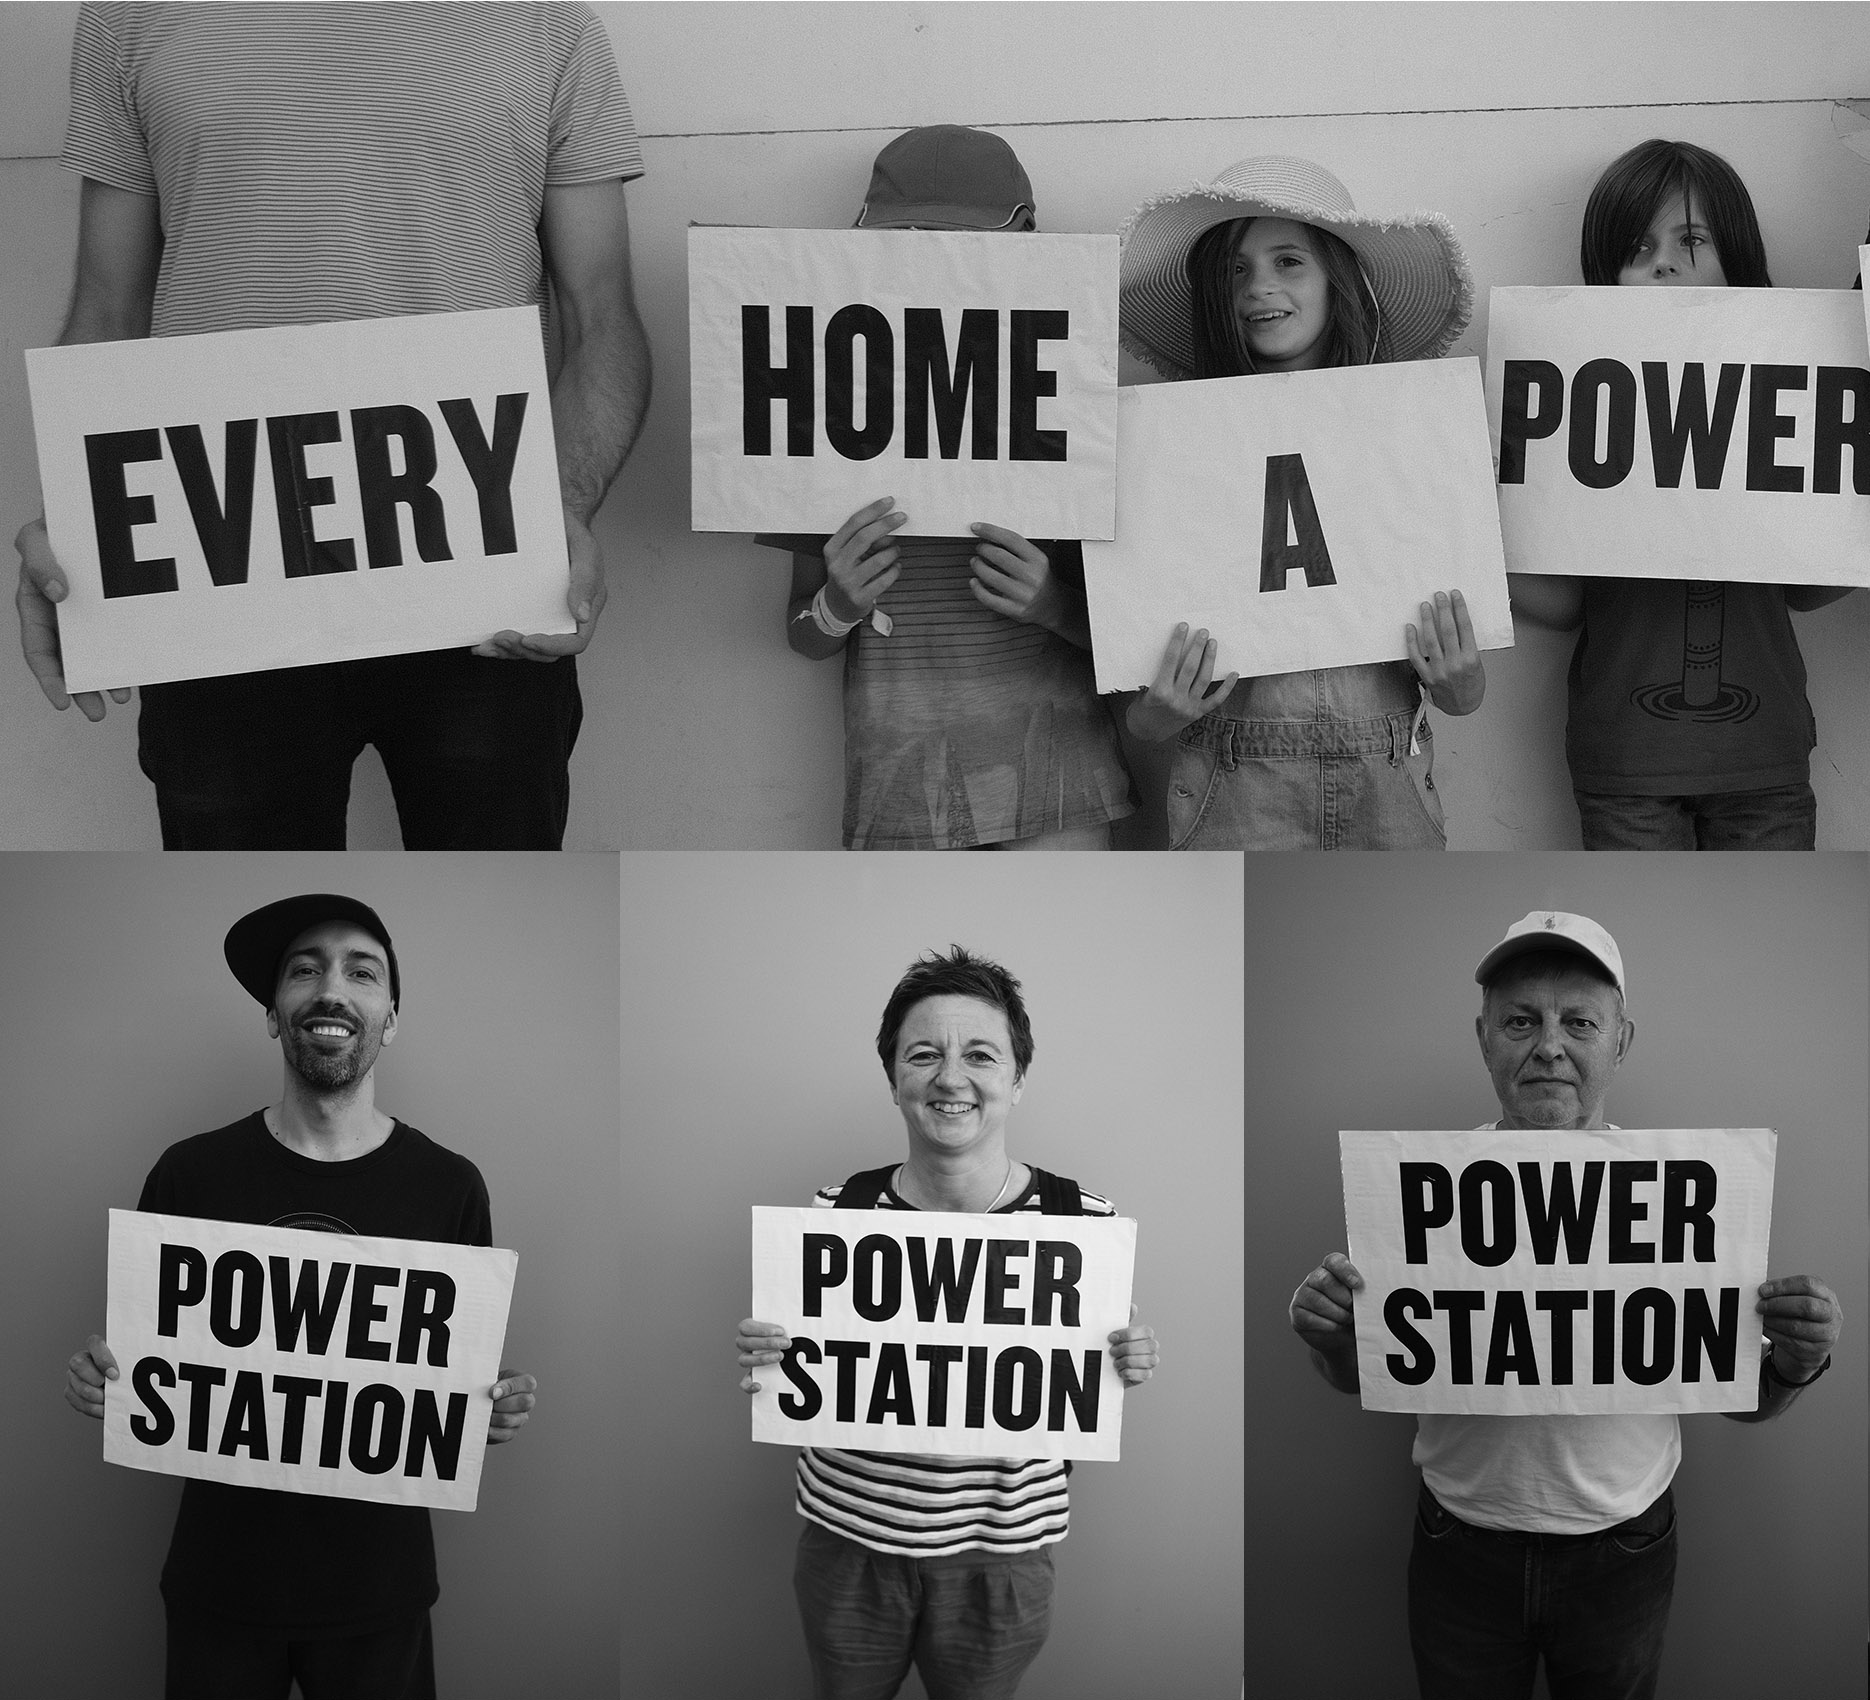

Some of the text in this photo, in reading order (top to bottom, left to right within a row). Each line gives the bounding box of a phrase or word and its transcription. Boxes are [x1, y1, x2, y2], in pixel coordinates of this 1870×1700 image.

[742, 304, 1069, 461] HOME
[84, 393, 529, 599] EVERY
[1259, 453, 1337, 593] A
[1400, 1160, 1717, 1267] POWER
[158, 1243, 456, 1367] POWER
[803, 1233, 1082, 1327] POWER
[1384, 1287, 1739, 1385] STATION
[130, 1357, 468, 1481] STATION
[776, 1336, 1102, 1432] STATION
